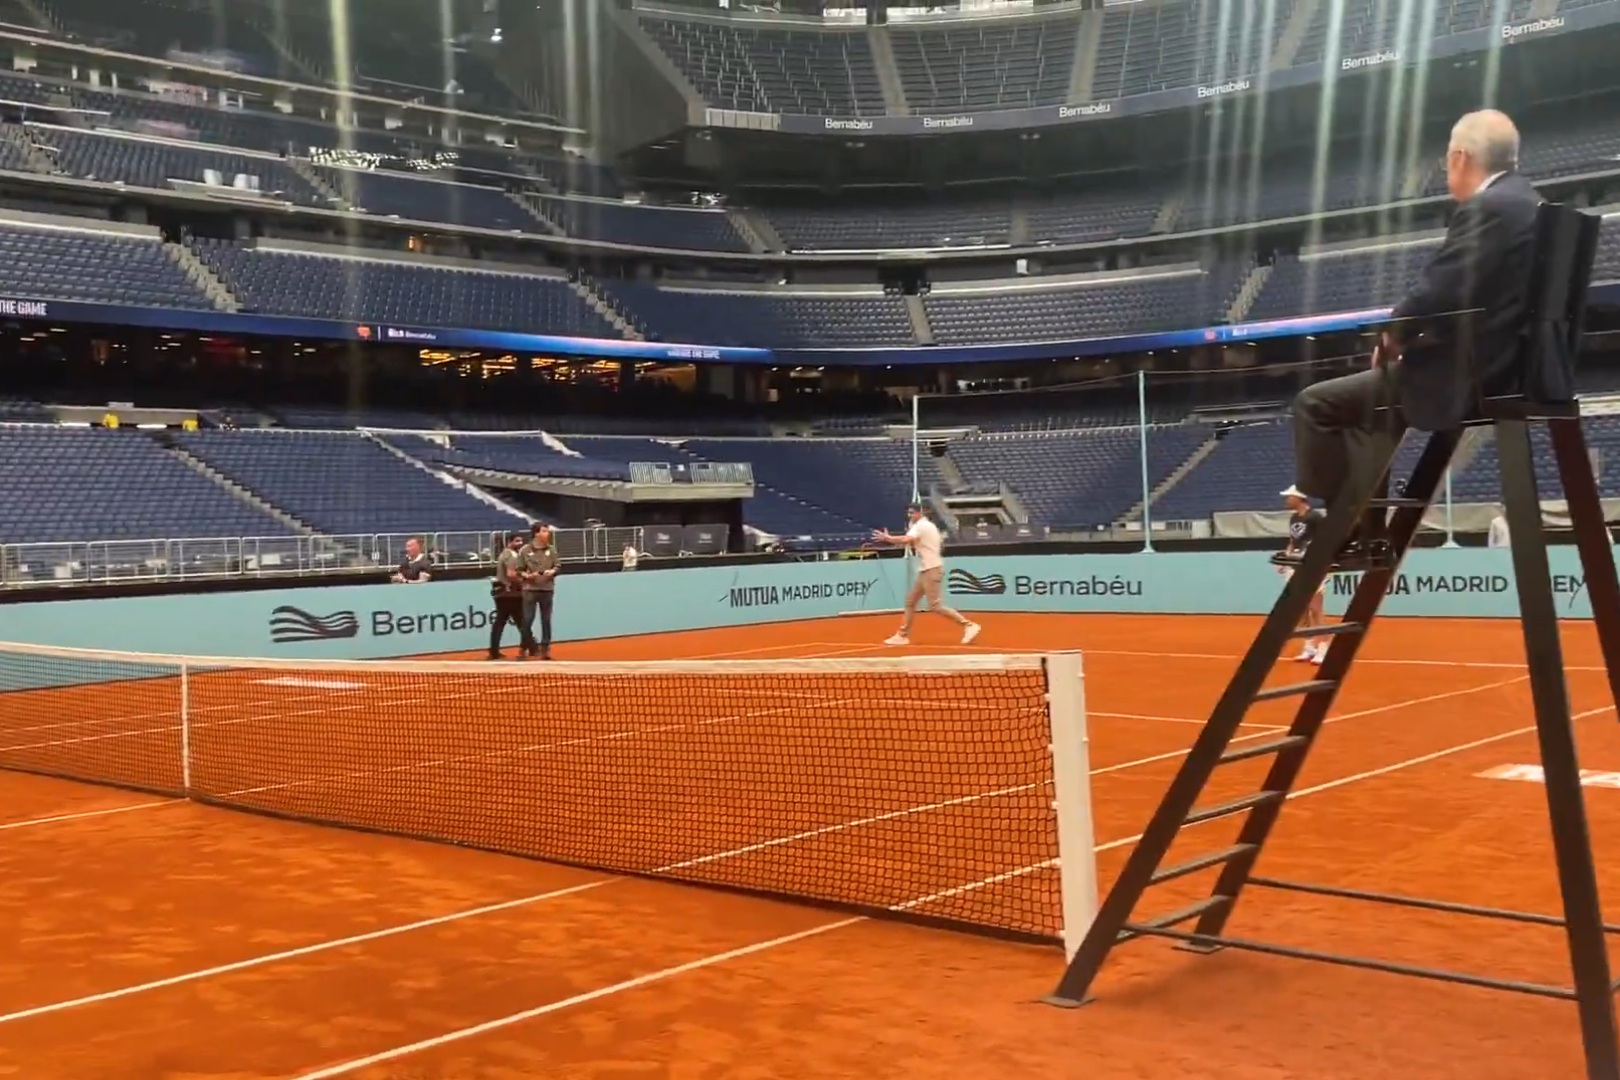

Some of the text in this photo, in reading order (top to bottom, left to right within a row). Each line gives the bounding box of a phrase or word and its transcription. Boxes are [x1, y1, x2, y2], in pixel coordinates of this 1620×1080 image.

[1501, 15, 1565, 39] Bernabéu
[1341, 50, 1402, 71] Bernabéu
[1197, 79, 1250, 99] Bernabéu
[1058, 103, 1111, 118] Bernabéu
[824, 117, 873, 130] Bernabéu
[18, 301, 48, 316] GAME
[730, 580, 871, 608] MUTUA MADRID OPEN
[1014, 574, 1143, 596] Bernabéu
[1416, 575, 1508, 593] MADRID
